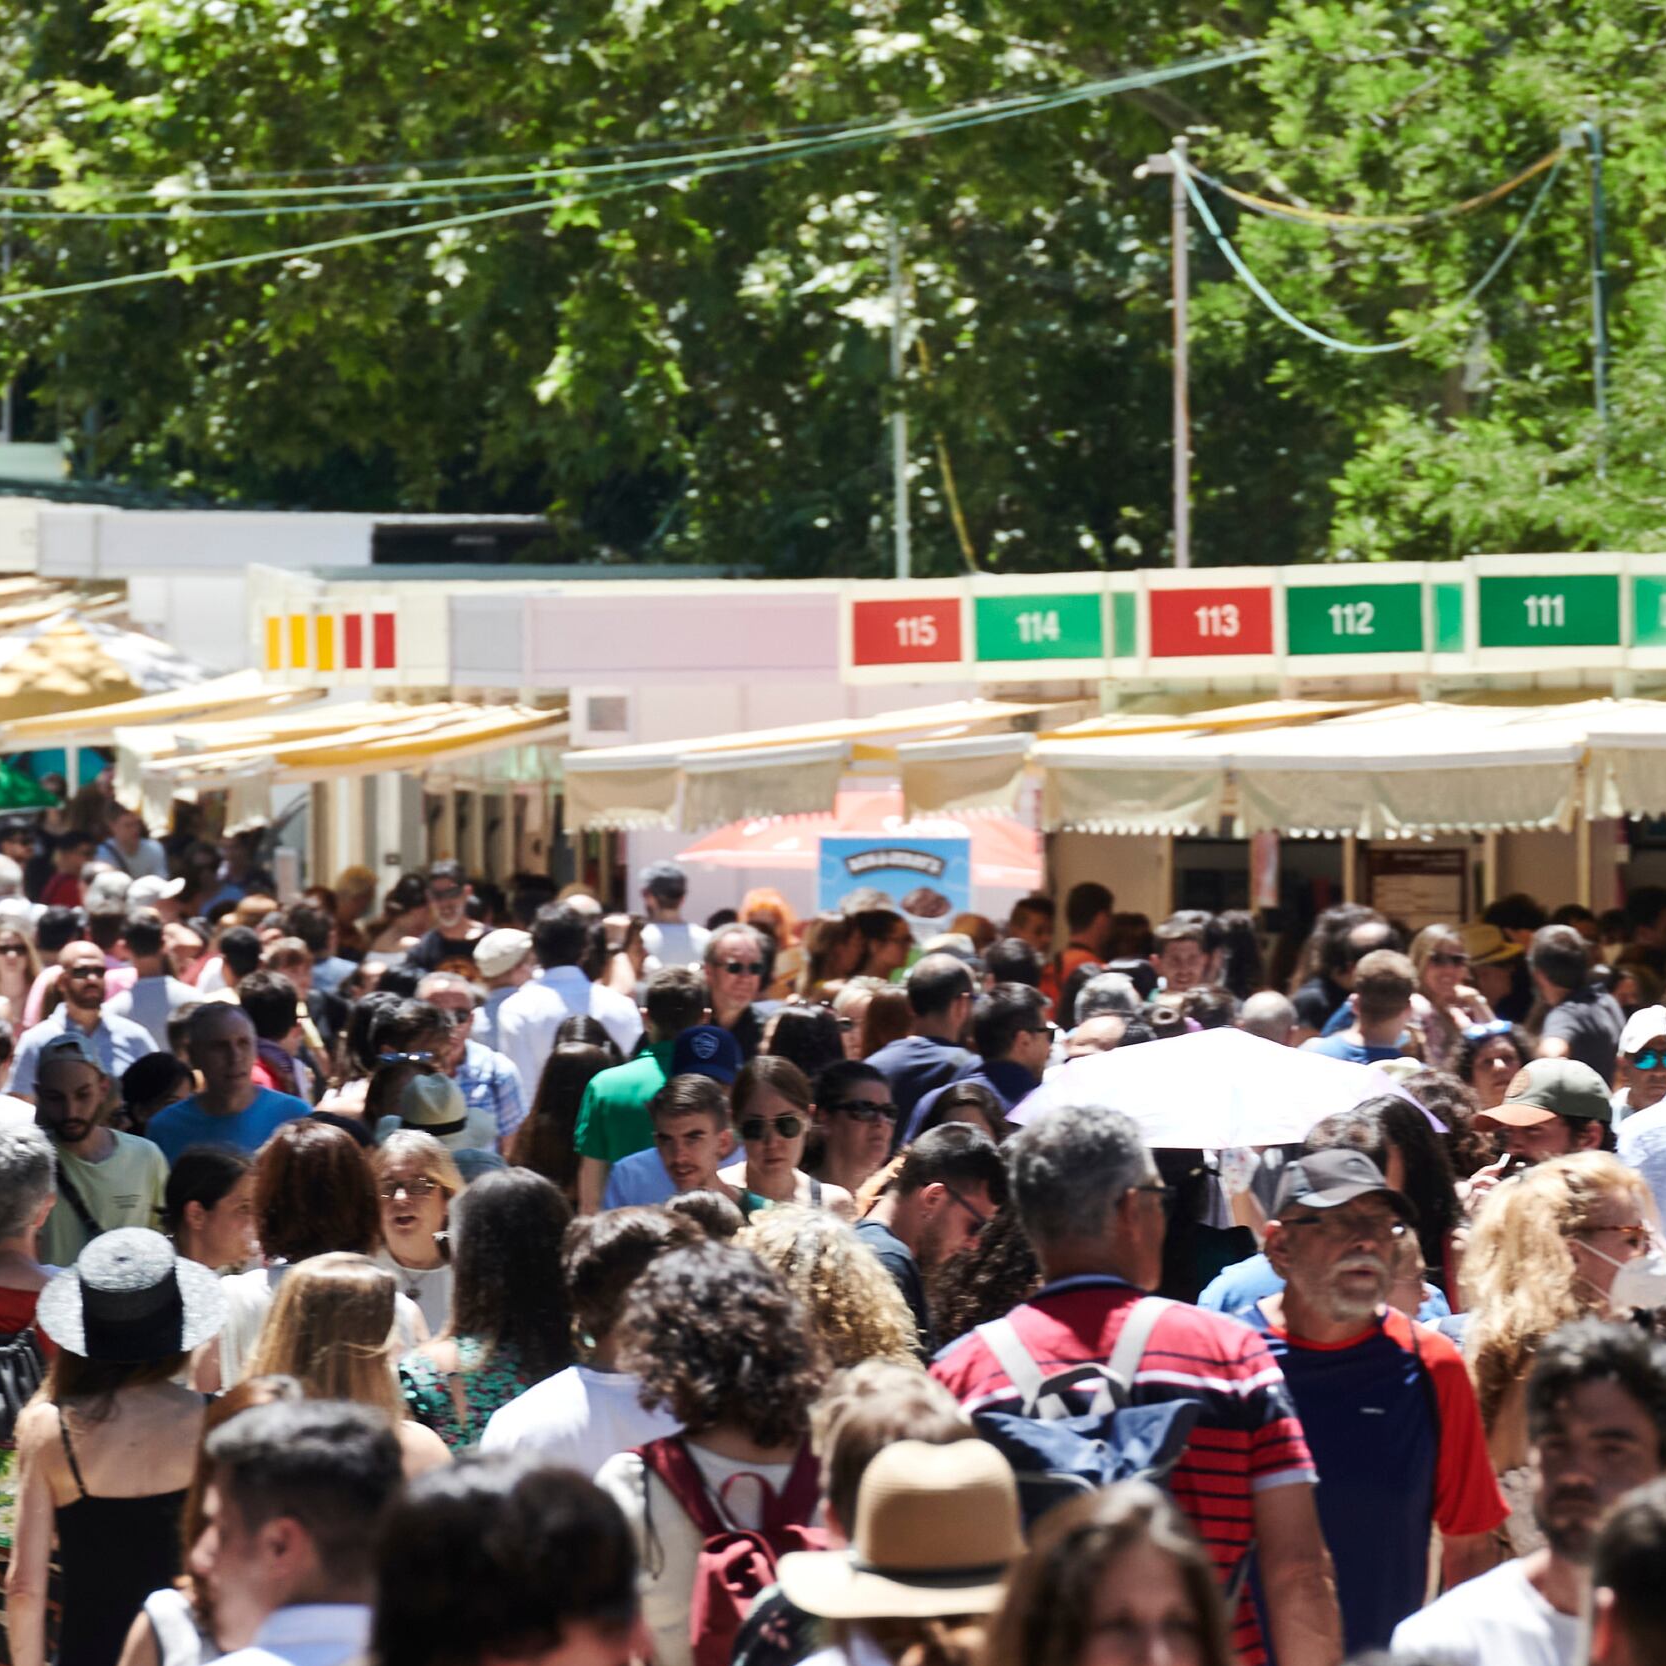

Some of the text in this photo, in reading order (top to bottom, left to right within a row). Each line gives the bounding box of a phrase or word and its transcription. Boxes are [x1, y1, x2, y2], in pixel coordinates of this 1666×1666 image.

[1016, 610, 1061, 644] 114
[1194, 604, 1240, 637] 113
[1328, 601, 1375, 635] 112
[1523, 594, 1565, 627] 111
[895, 614, 938, 647] 115
